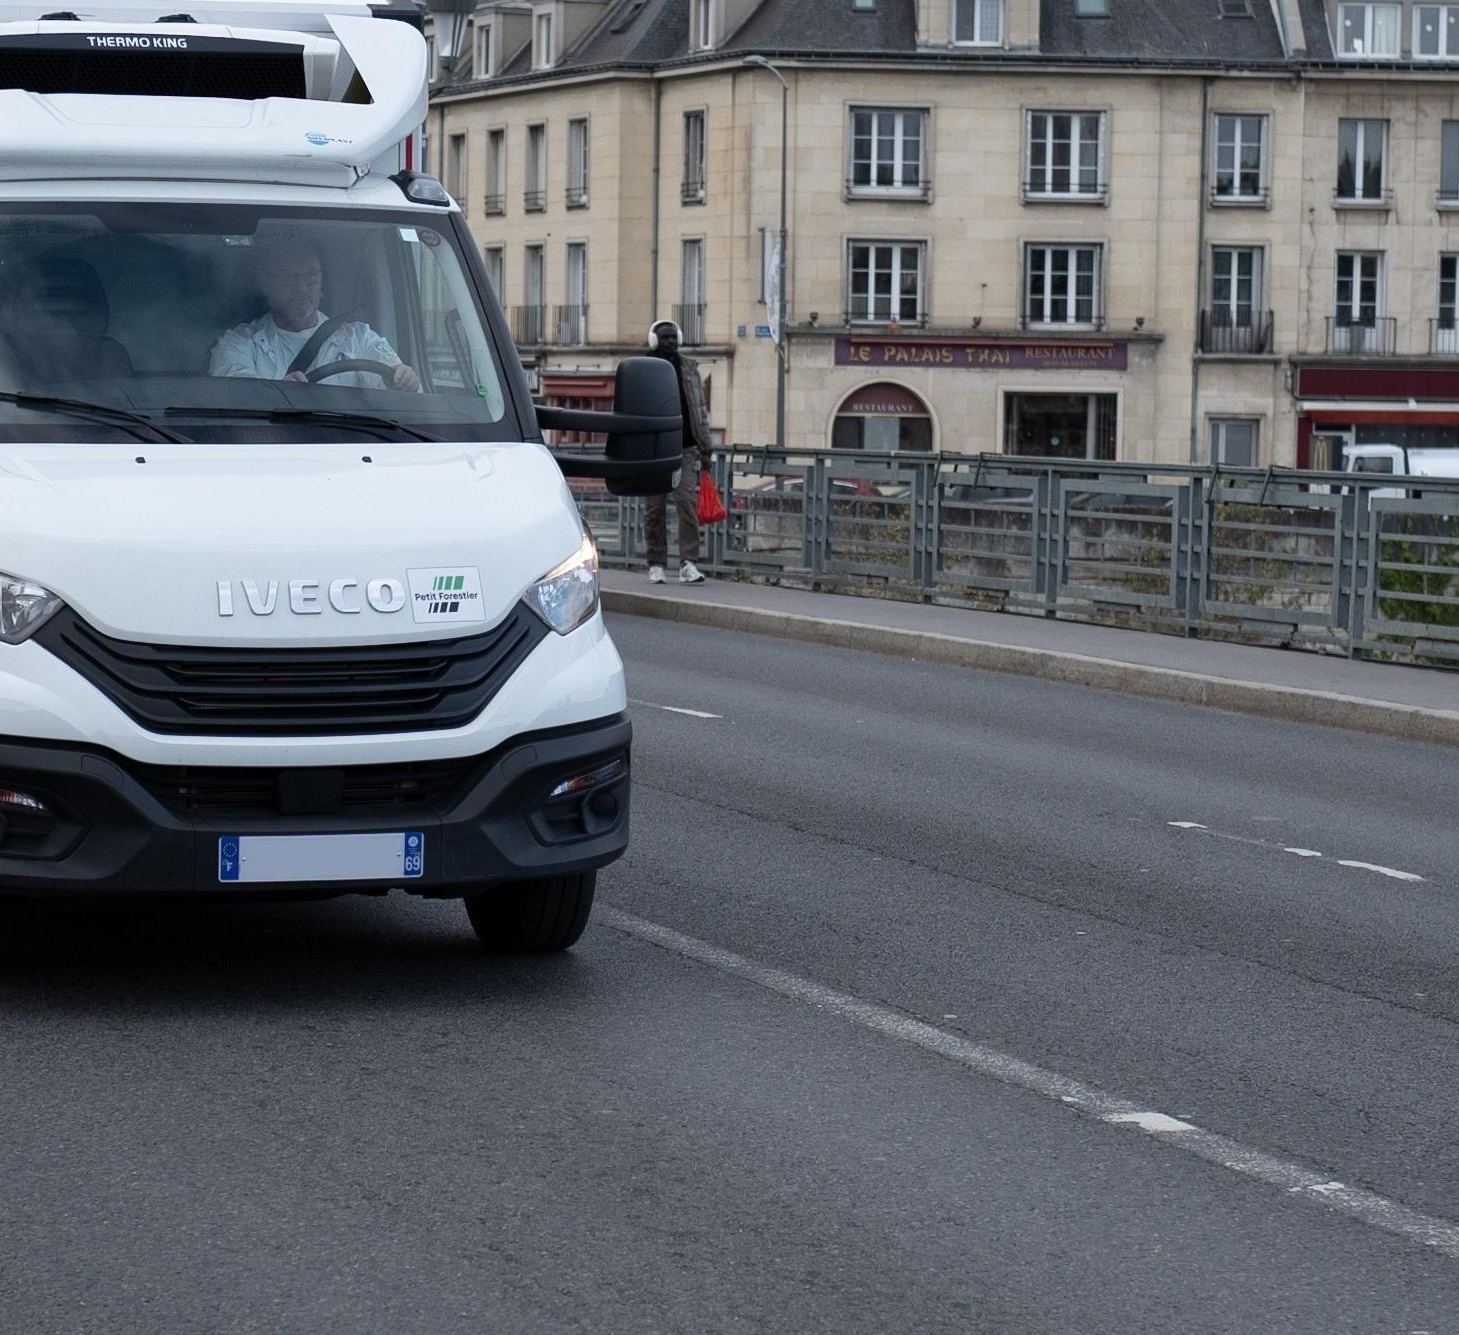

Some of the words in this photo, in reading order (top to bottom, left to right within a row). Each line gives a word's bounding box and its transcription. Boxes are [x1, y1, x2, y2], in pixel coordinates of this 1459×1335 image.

[86, 36, 150, 48] THERMO
[153, 37, 188, 49] KING
[849, 347, 872, 362] LE
[883, 347, 954, 363] PALAIS
[964, 348, 1012, 363] THAI
[1025, 347, 1115, 360] RESTAURANT
[852, 403, 914, 412] RESTAURANT
[216, 577, 406, 617] IVECO
[414, 593, 436, 601] Petit
[438, 590, 478, 600] Forestier
[405, 856, 421, 871] 69
